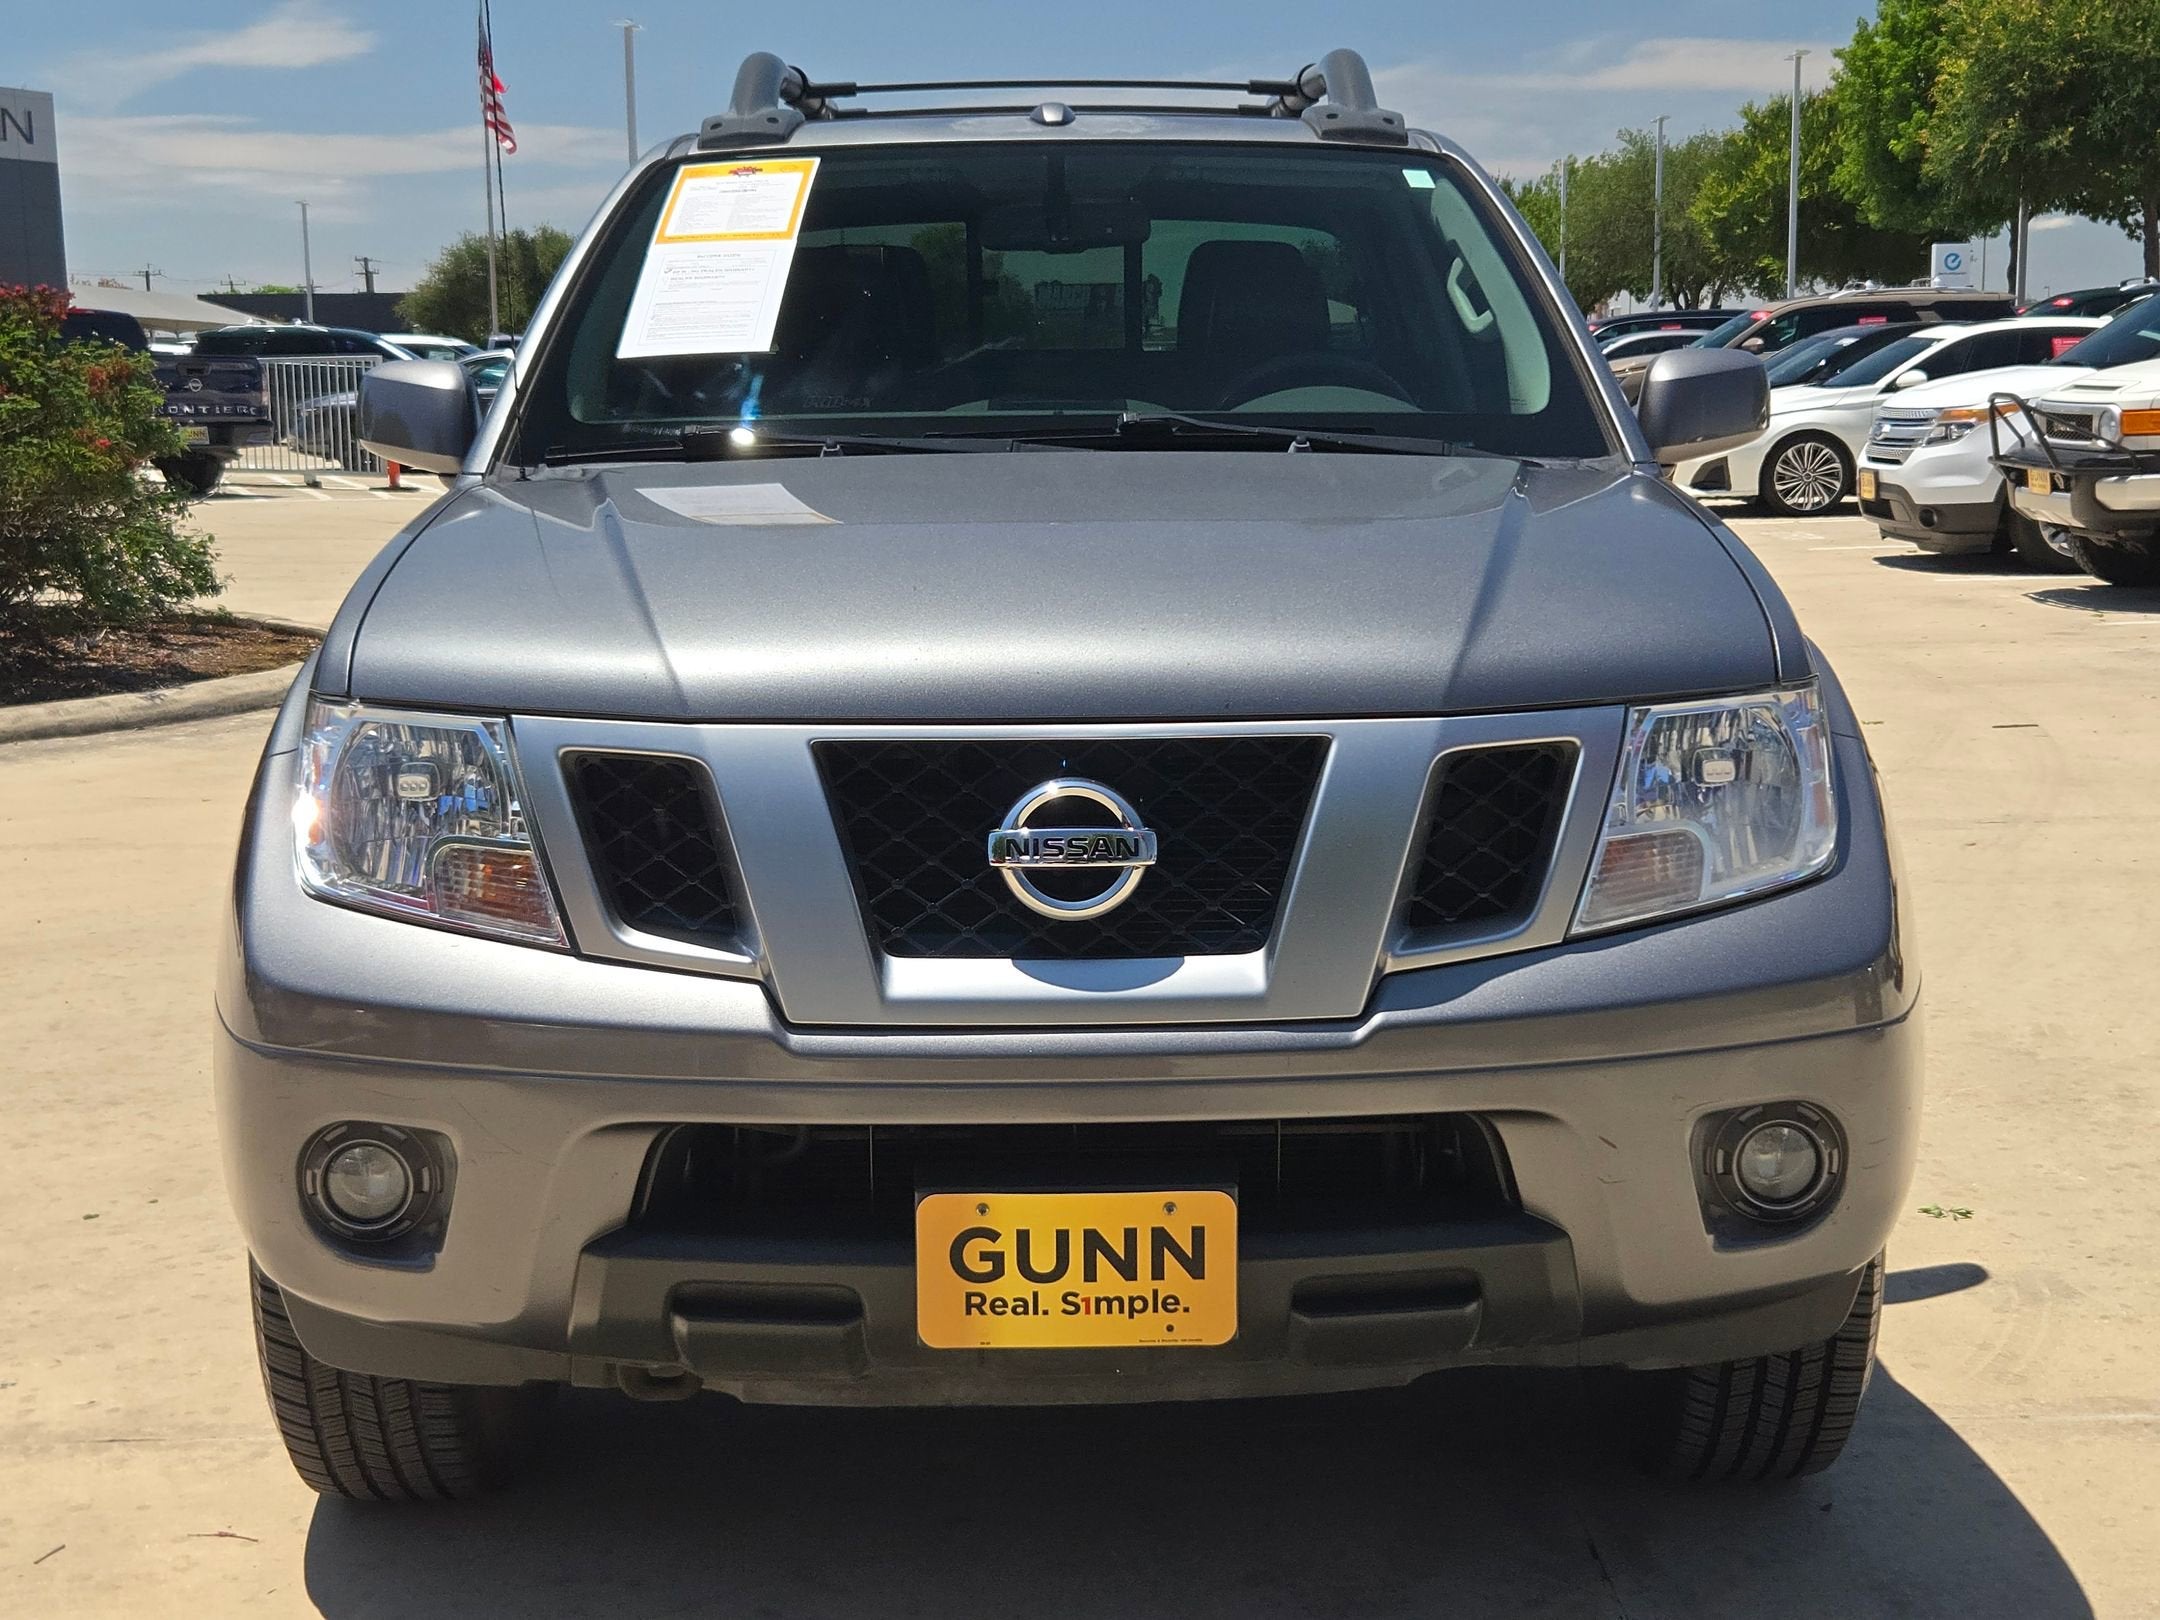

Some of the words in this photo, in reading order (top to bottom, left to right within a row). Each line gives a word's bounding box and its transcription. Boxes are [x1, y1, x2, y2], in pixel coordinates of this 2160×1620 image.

[1004, 836, 1139, 858] NISSAN
[949, 1225, 1206, 1284] GUNN
[964, 1290, 1049, 1316] Real.
